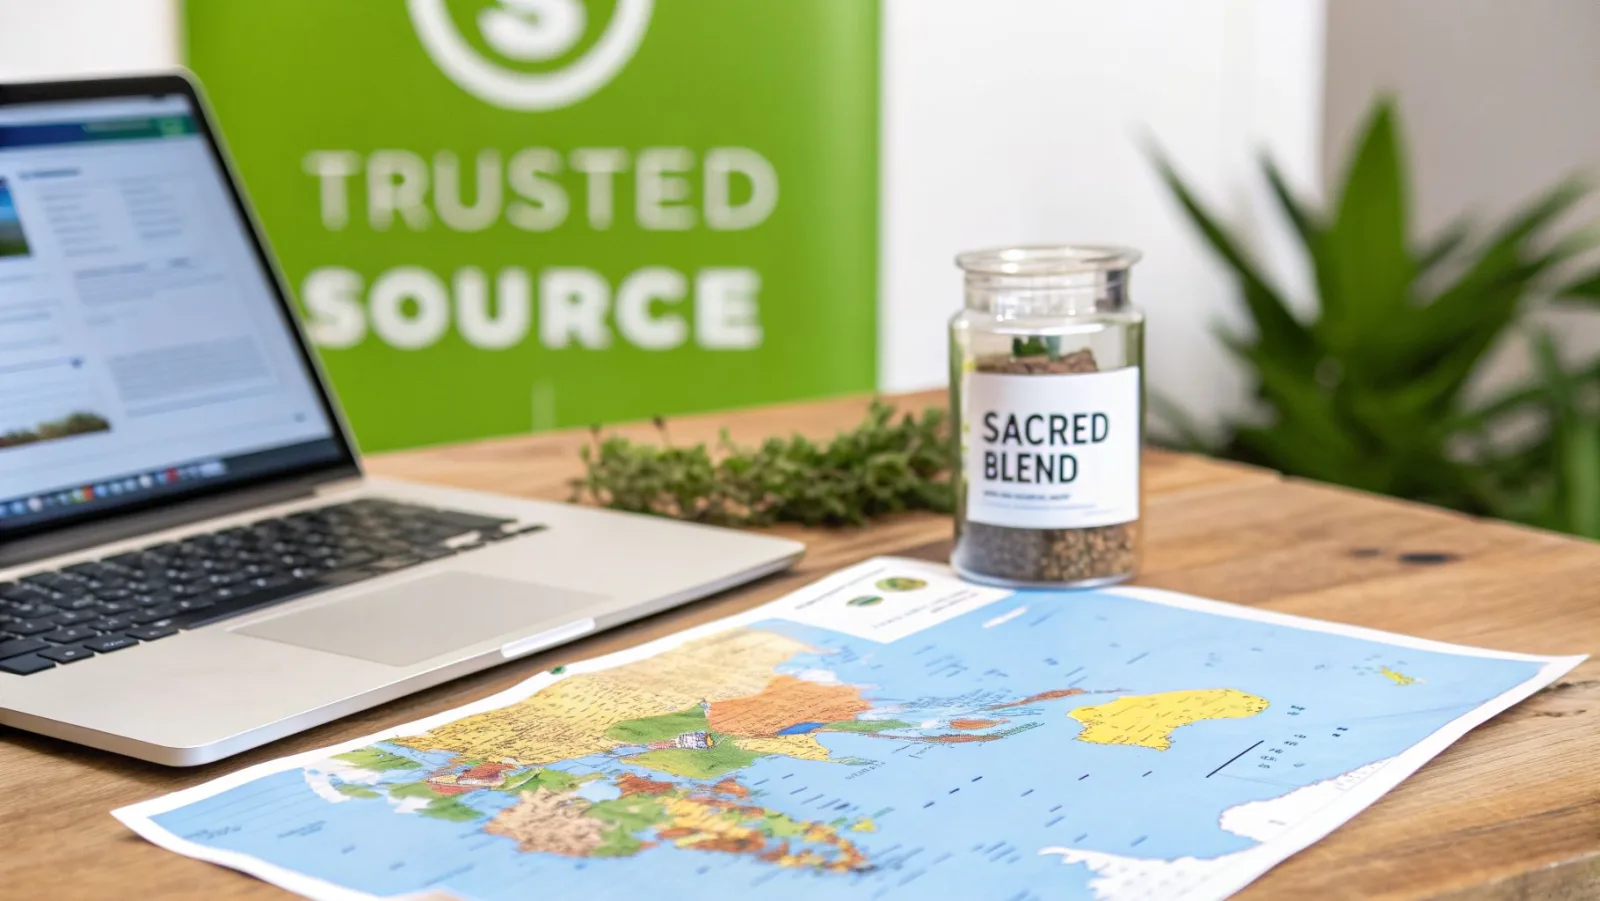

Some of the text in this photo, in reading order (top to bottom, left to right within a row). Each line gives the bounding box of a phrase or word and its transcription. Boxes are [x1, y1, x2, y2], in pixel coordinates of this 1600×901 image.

[303, 147, 779, 231] TRUSTED
[302, 265, 764, 351] SOURCE
[982, 411, 1109, 446] SACRED
[984, 451, 1078, 484] BLEND
